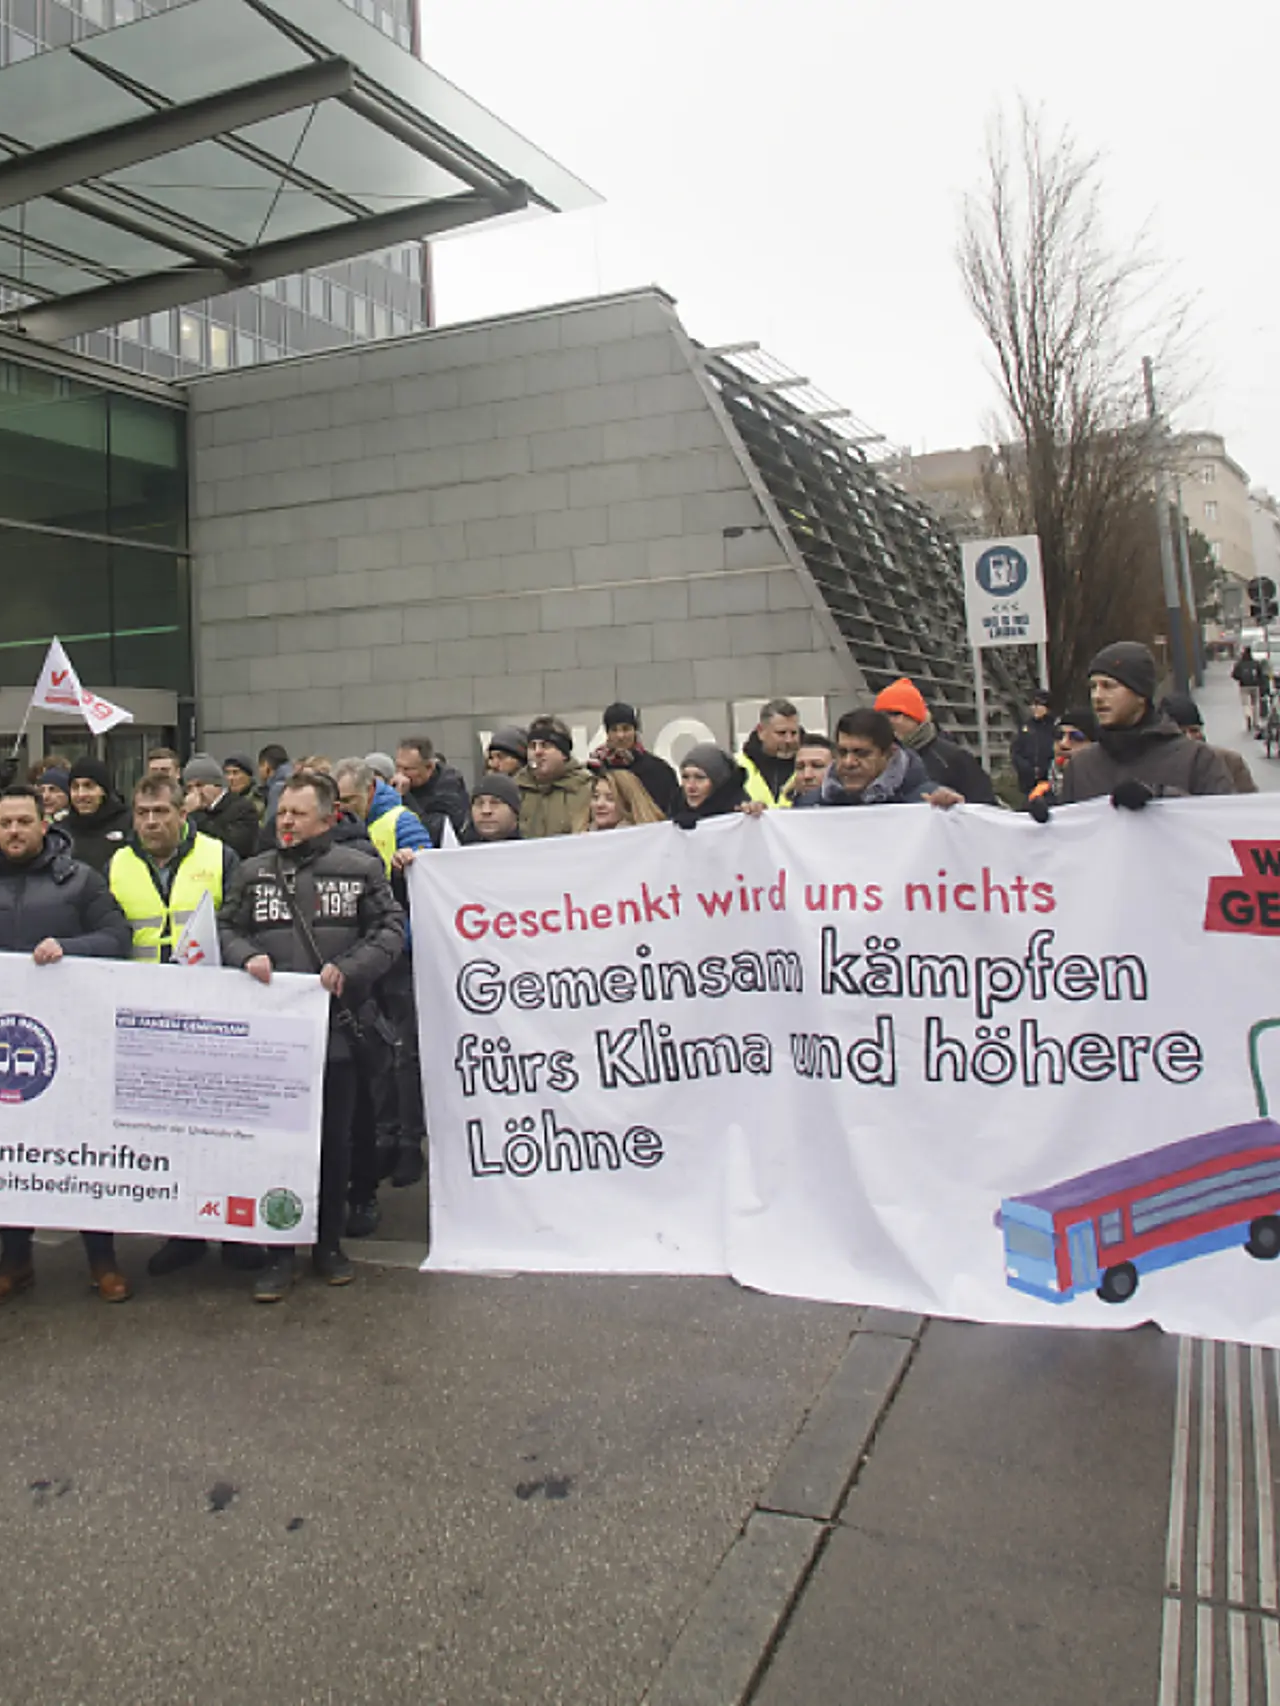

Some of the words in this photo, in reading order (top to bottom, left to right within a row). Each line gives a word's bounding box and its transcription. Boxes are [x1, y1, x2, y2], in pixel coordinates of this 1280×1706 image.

[455, 881, 683, 941] Geschenkt
[695, 872, 786, 917] wird
[804, 879, 883, 914] uns
[905, 867, 1057, 915] nichts
[456, 944, 804, 1014] Gemeinsam
[820, 927, 1147, 1015] kämpfen
[455, 1032, 580, 1096] fürs
[596, 1018, 773, 1090] Klima
[790, 1016, 895, 1085] und
[924, 1016, 1203, 1088] höhere
[467, 1109, 665, 1178] Löhne
